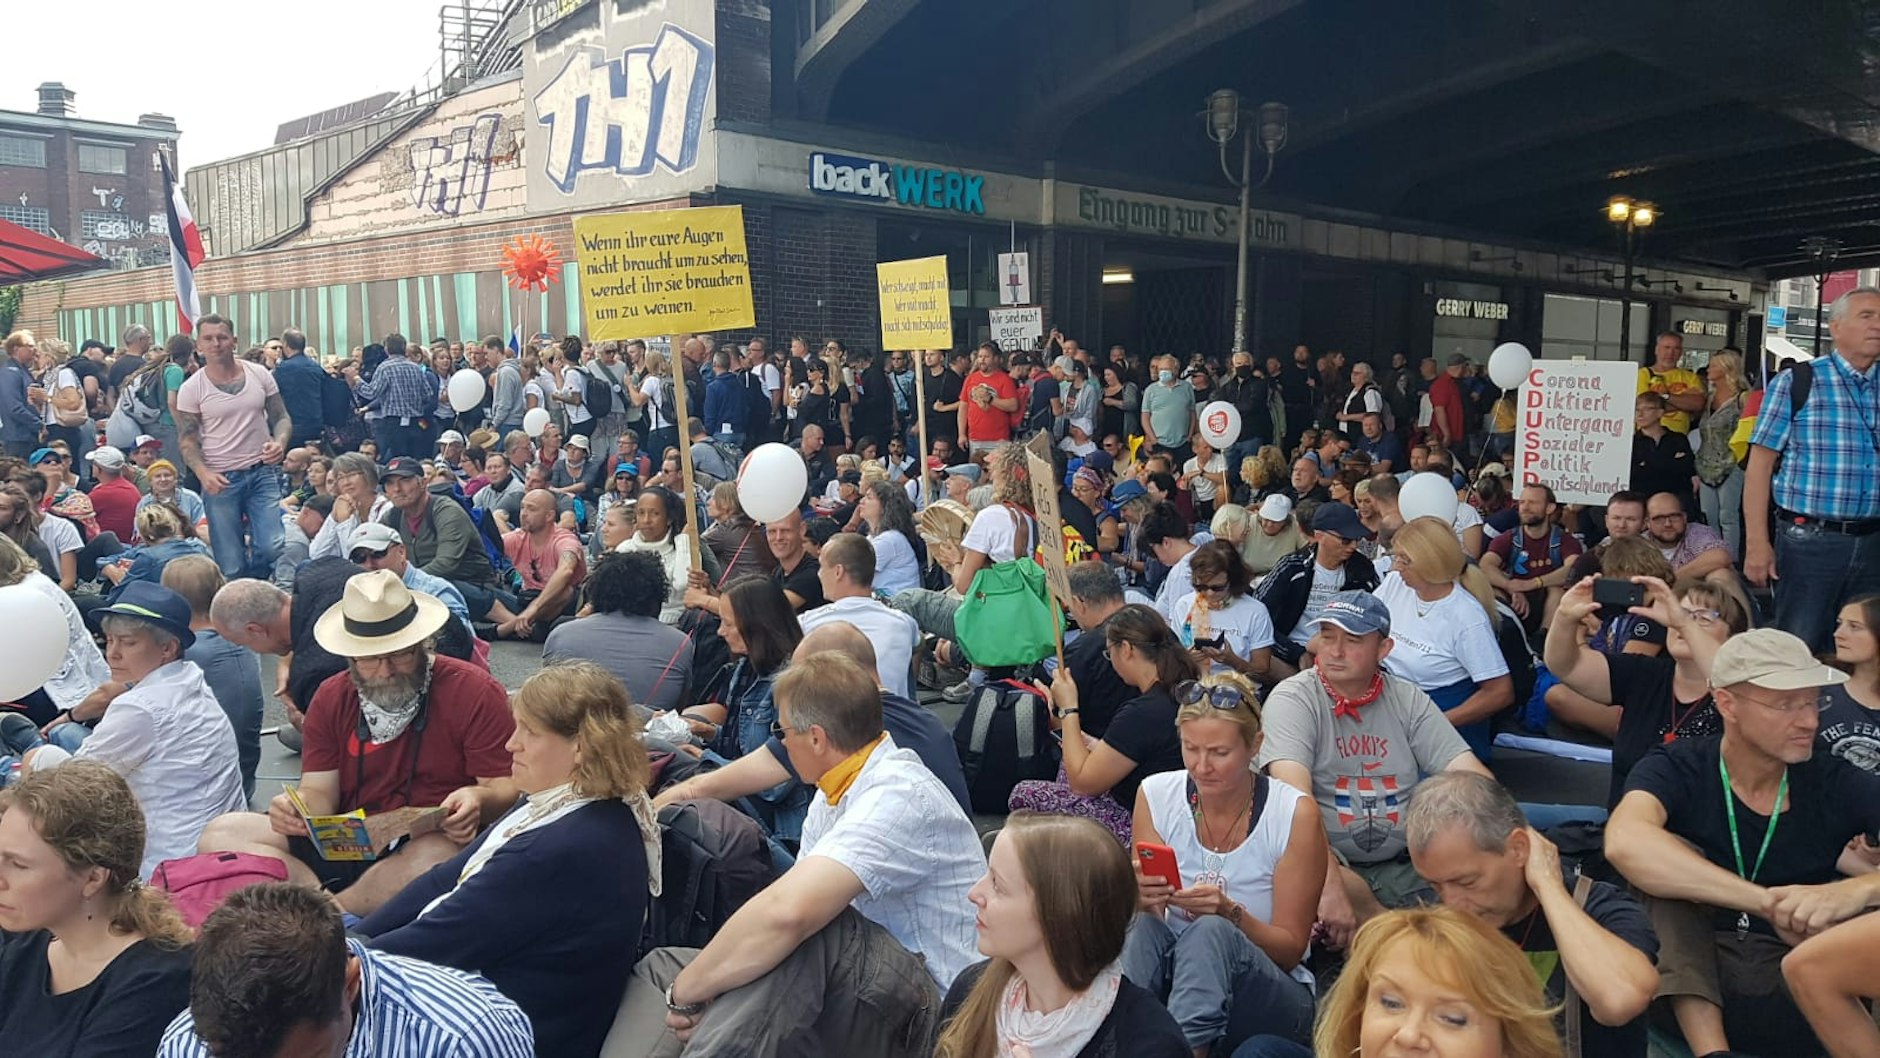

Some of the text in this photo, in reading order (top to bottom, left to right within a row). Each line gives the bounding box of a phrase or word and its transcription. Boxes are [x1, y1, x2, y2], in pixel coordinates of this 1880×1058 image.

[1079, 186, 1288, 243] Eingang zur S-ahn
[581, 226, 724, 252] Wenn ihr eure Augen
[587, 247, 748, 275] nicht braucht um zu sehen,
[591, 270, 744, 298] werdet ihr sie brauchen
[595, 307, 618, 320] um
[622, 306, 639, 318] zu
[644, 297, 697, 315] weinen.
[1005, 310, 1020, 323] sind
[1021, 310, 1038, 322] nicht
[1436, 298, 1509, 320] GERRY WEBER
[1000, 326, 1025, 338] euer
[1683, 319, 1727, 336] GERRY WEBER
[1529, 369, 1601, 391] Corona
[1527, 390, 1612, 411] Diktiert
[1526, 411, 1624, 437] Untergang
[1525, 432, 1605, 454] Sozialer
[1523, 451, 1592, 473] Politik
[1820, 722, 1849, 742] THE
[1336, 734, 1388, 759] FLOKI'S
